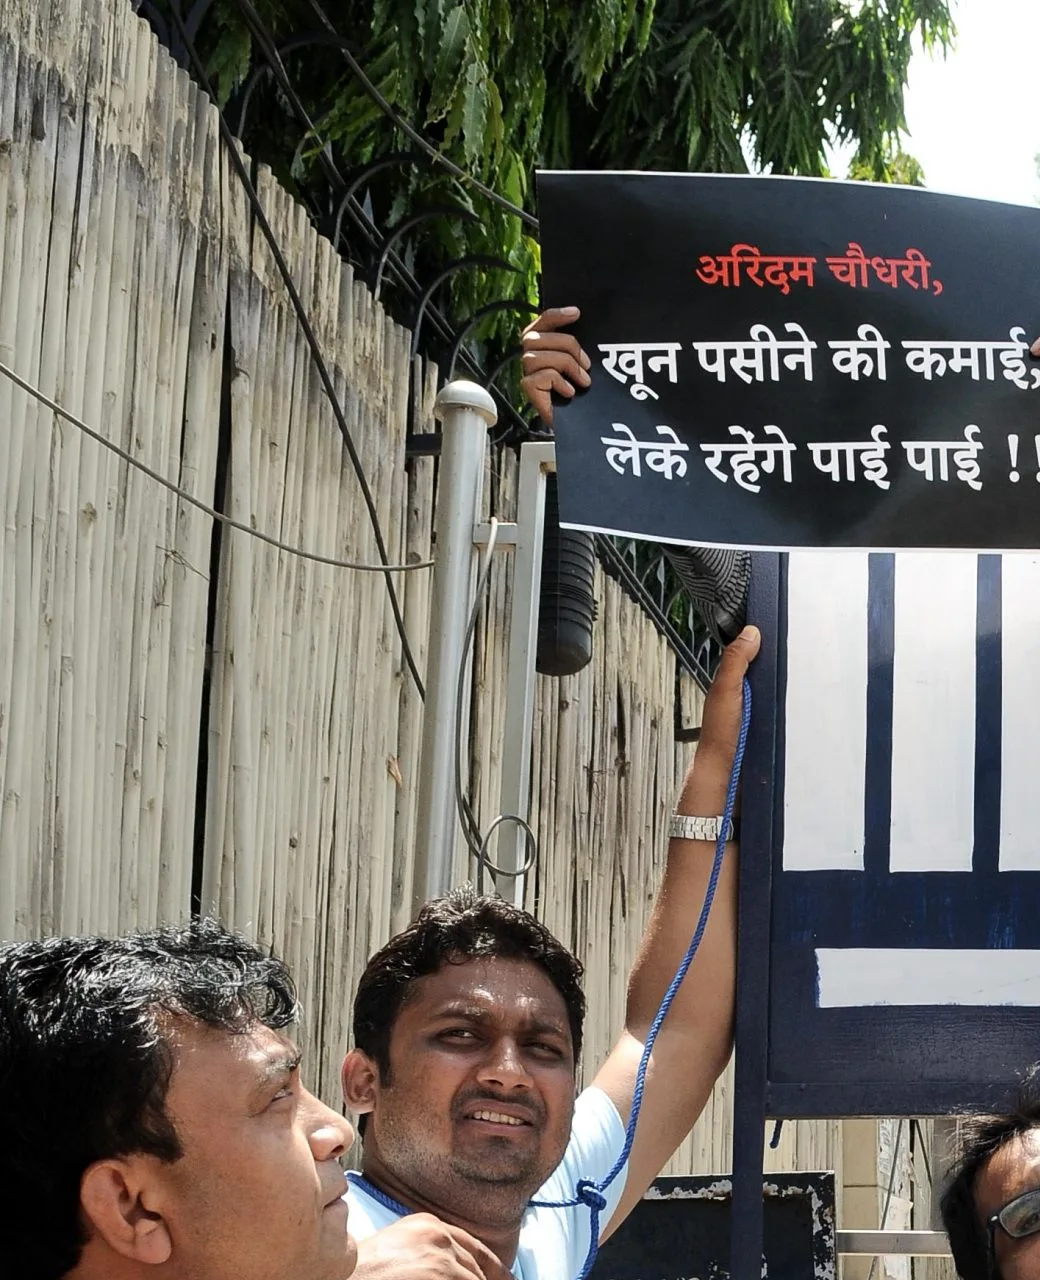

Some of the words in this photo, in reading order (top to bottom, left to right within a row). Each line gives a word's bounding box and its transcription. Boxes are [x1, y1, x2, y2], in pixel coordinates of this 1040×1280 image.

[696, 243, 817, 295] अरिंदम
[827, 242, 943, 296] चौधरी,
[598, 342, 682, 400] खून
[693, 322, 818, 385] पसीने
[828, 323, 892, 381] की
[601, 422, 690, 480] लेके
[700, 424, 797, 493] रहेंगे
[807, 424, 892, 490] पाई
[901, 424, 984, 491] पाई
